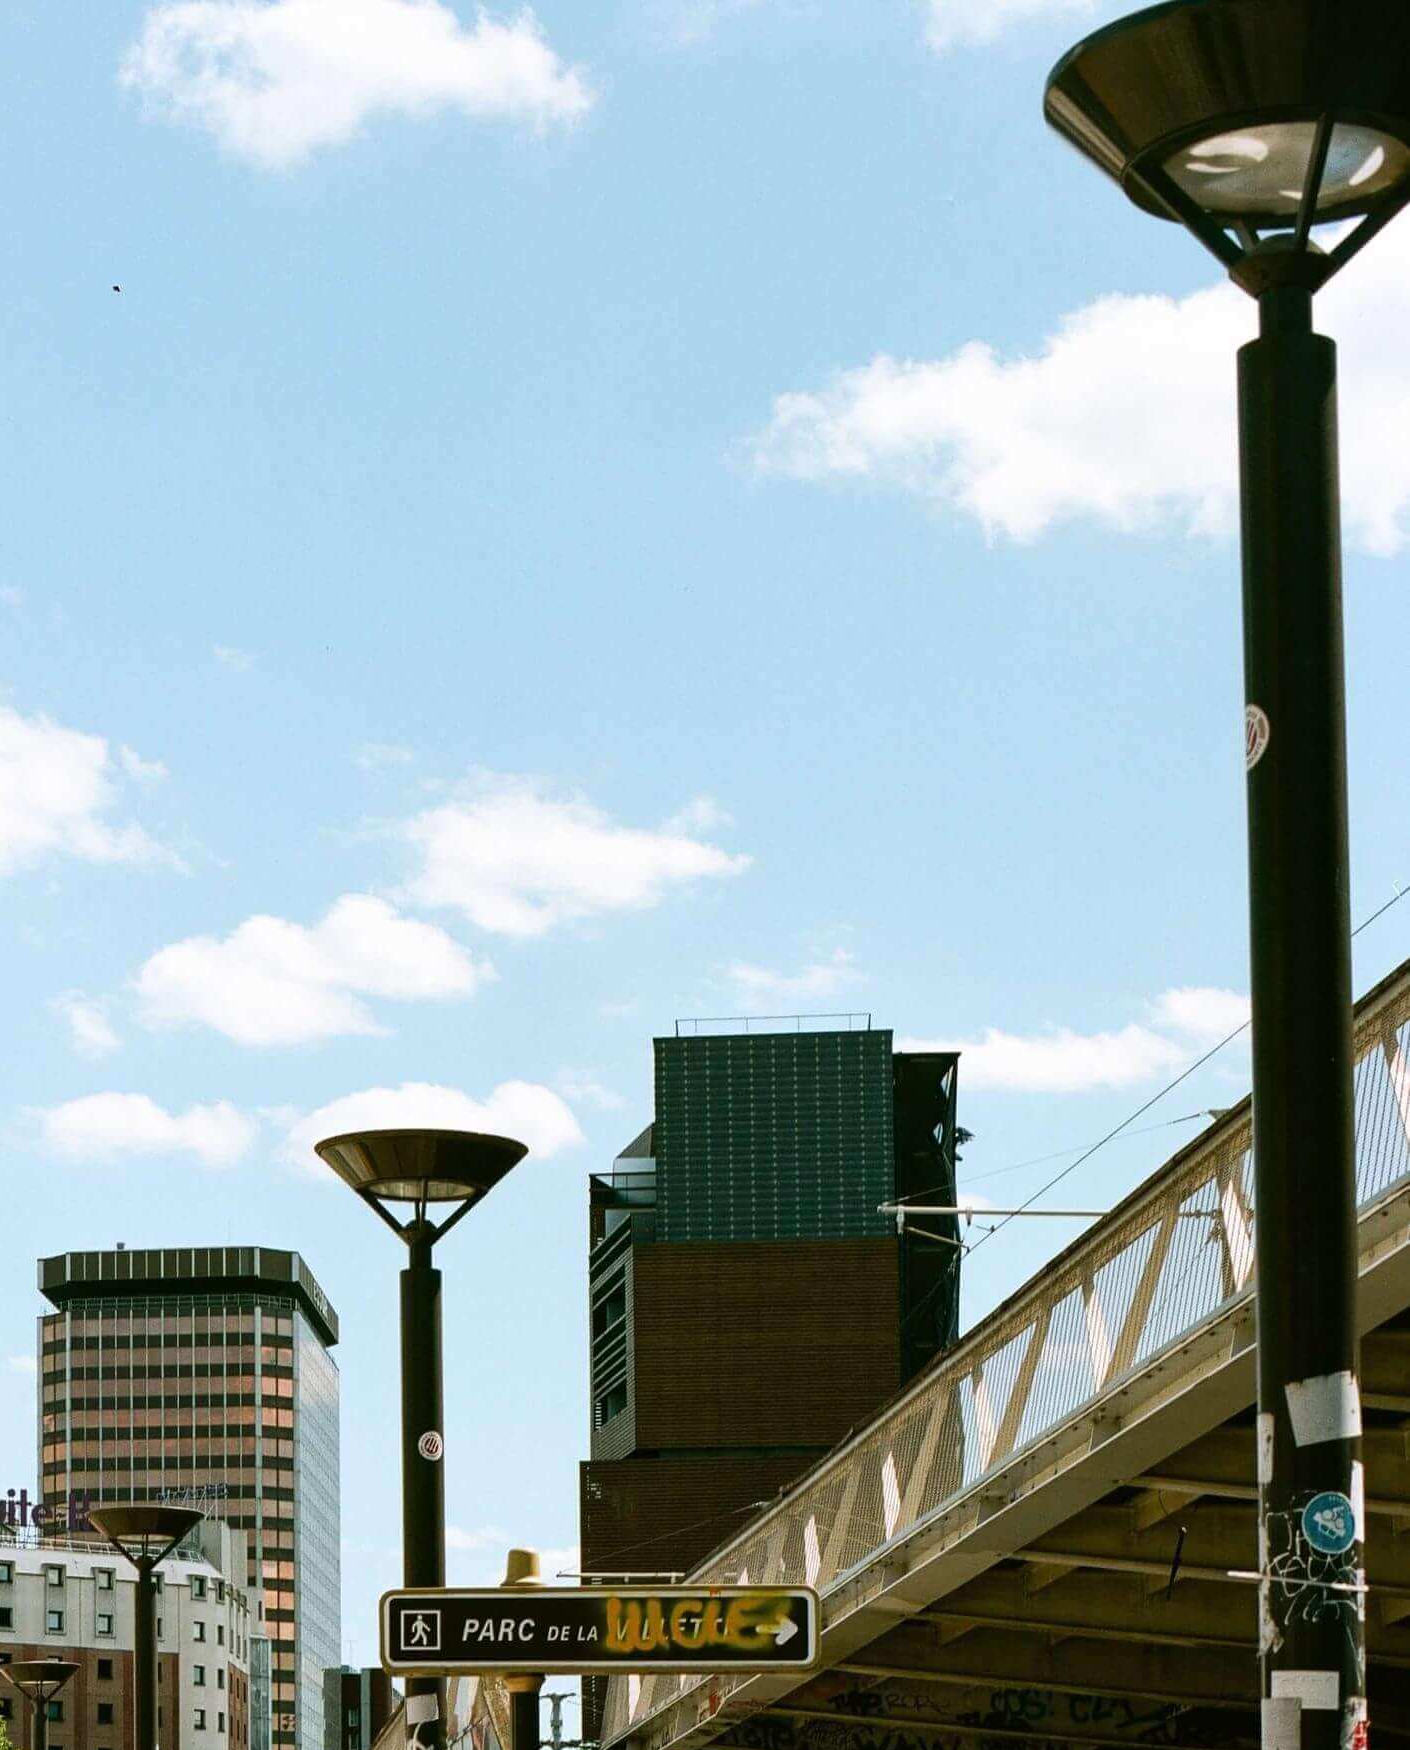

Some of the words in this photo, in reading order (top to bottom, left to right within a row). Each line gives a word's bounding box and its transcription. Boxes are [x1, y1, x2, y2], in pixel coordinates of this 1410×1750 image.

[461, 1618, 536, 1642] PARC
[547, 1625, 571, 1642] DE
[577, 1625, 599, 1642] LA
